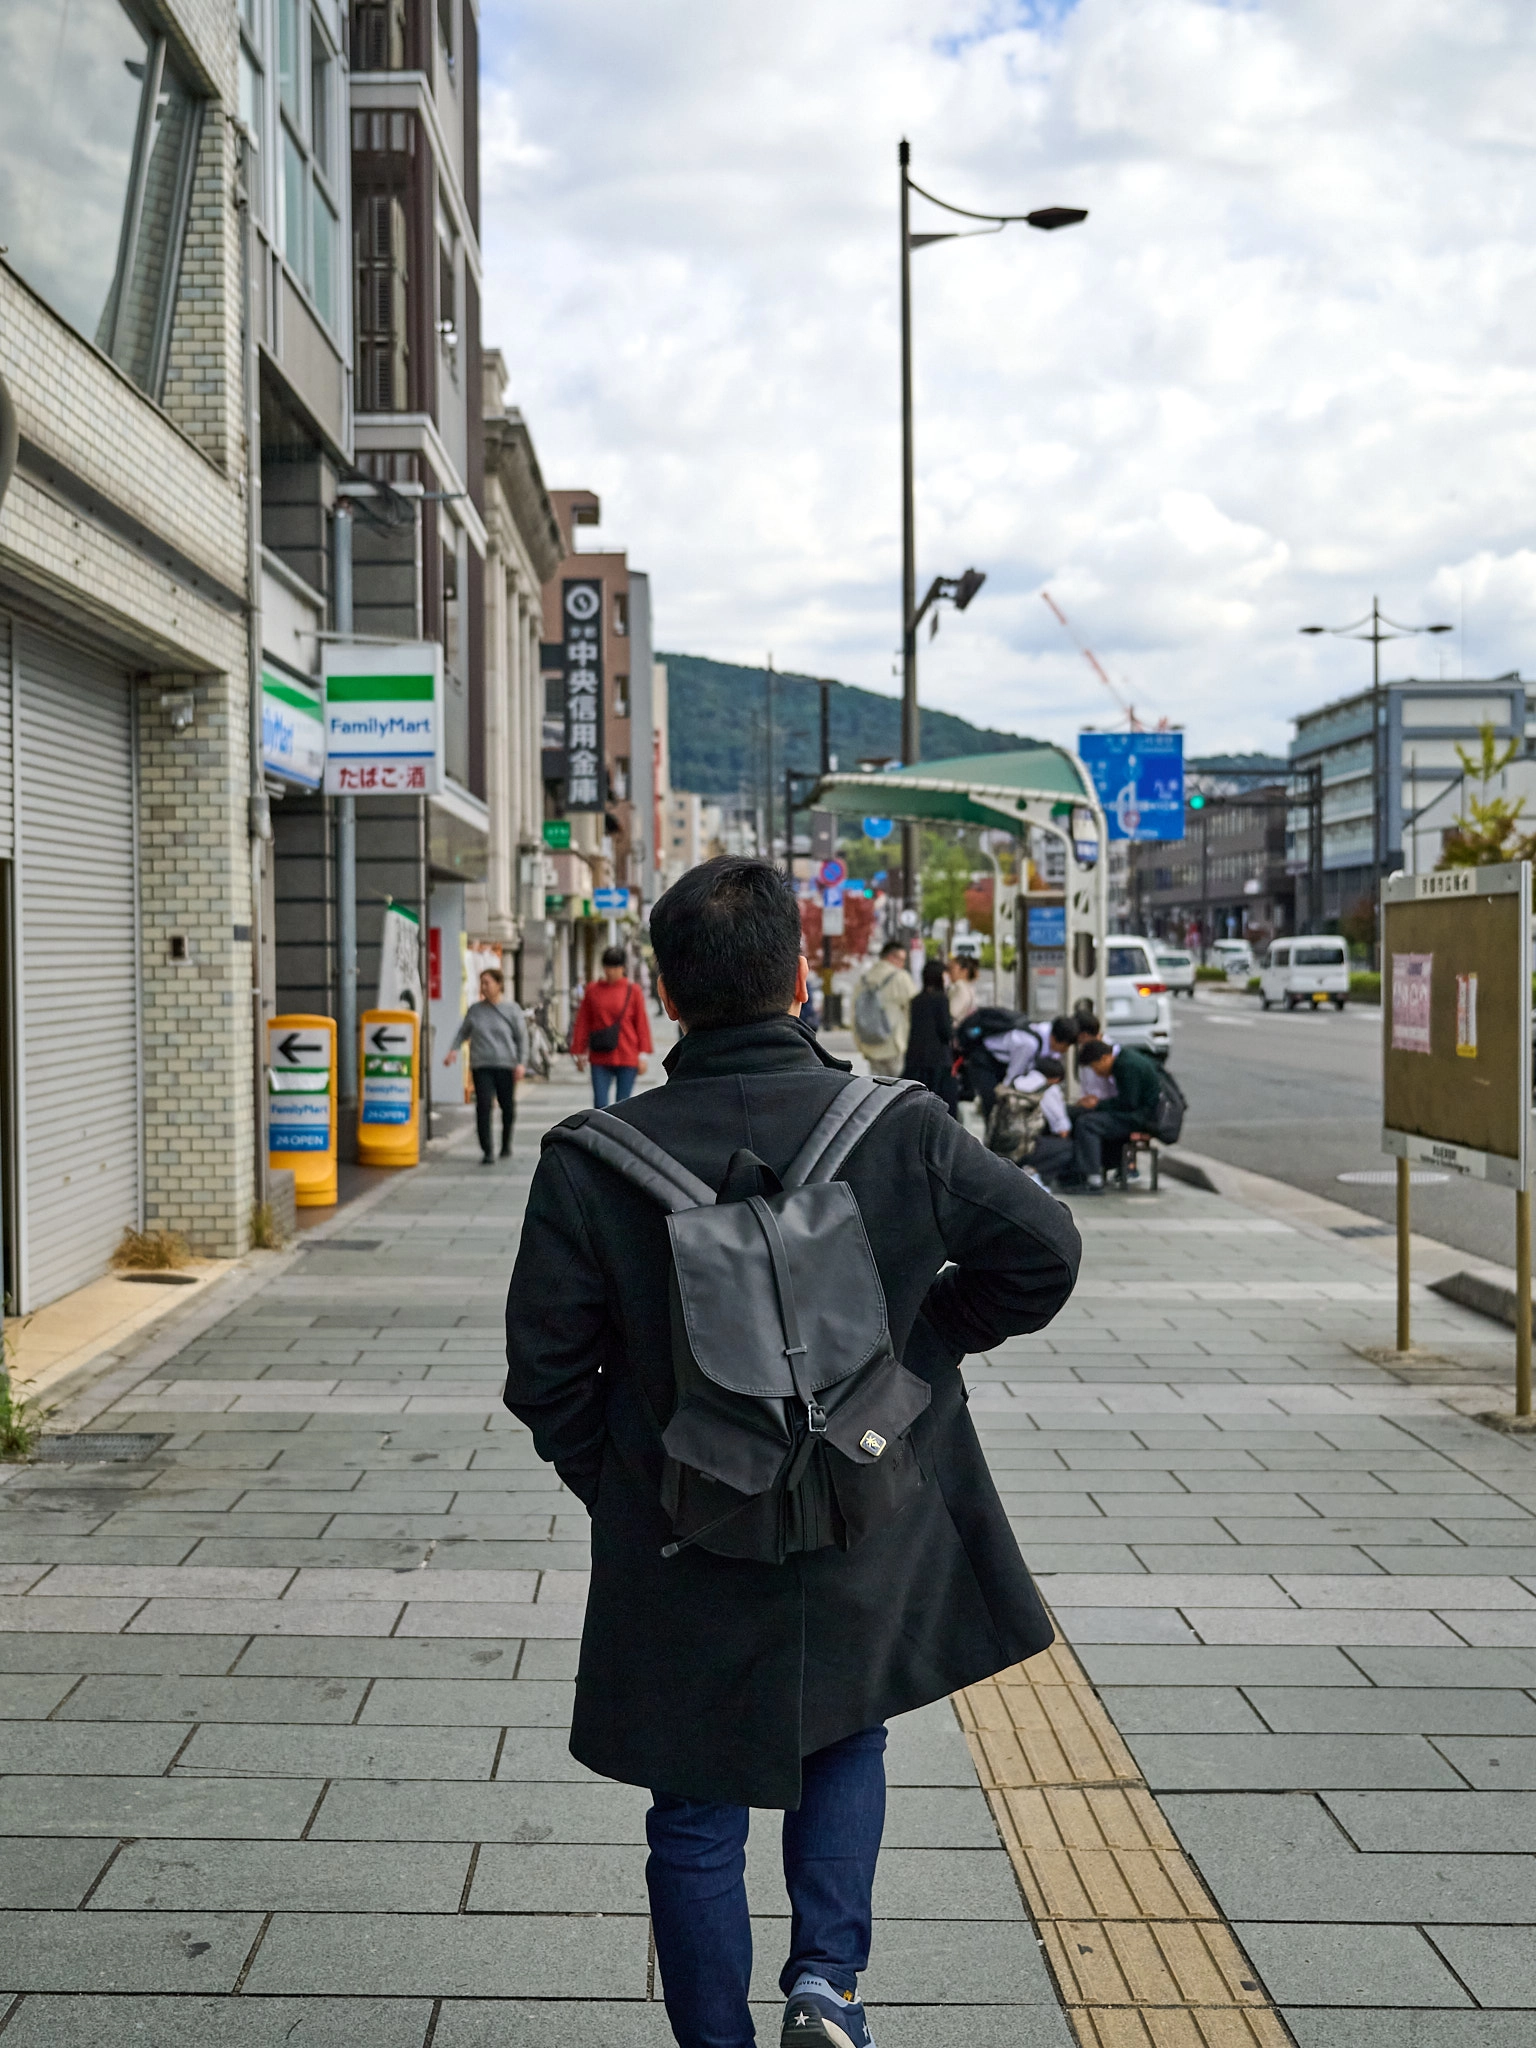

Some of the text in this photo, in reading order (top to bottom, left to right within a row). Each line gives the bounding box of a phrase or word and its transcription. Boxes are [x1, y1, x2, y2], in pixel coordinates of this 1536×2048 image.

[331, 717, 430, 738] FamilyMart
[568, 641, 599, 804] 中央信用金庫
